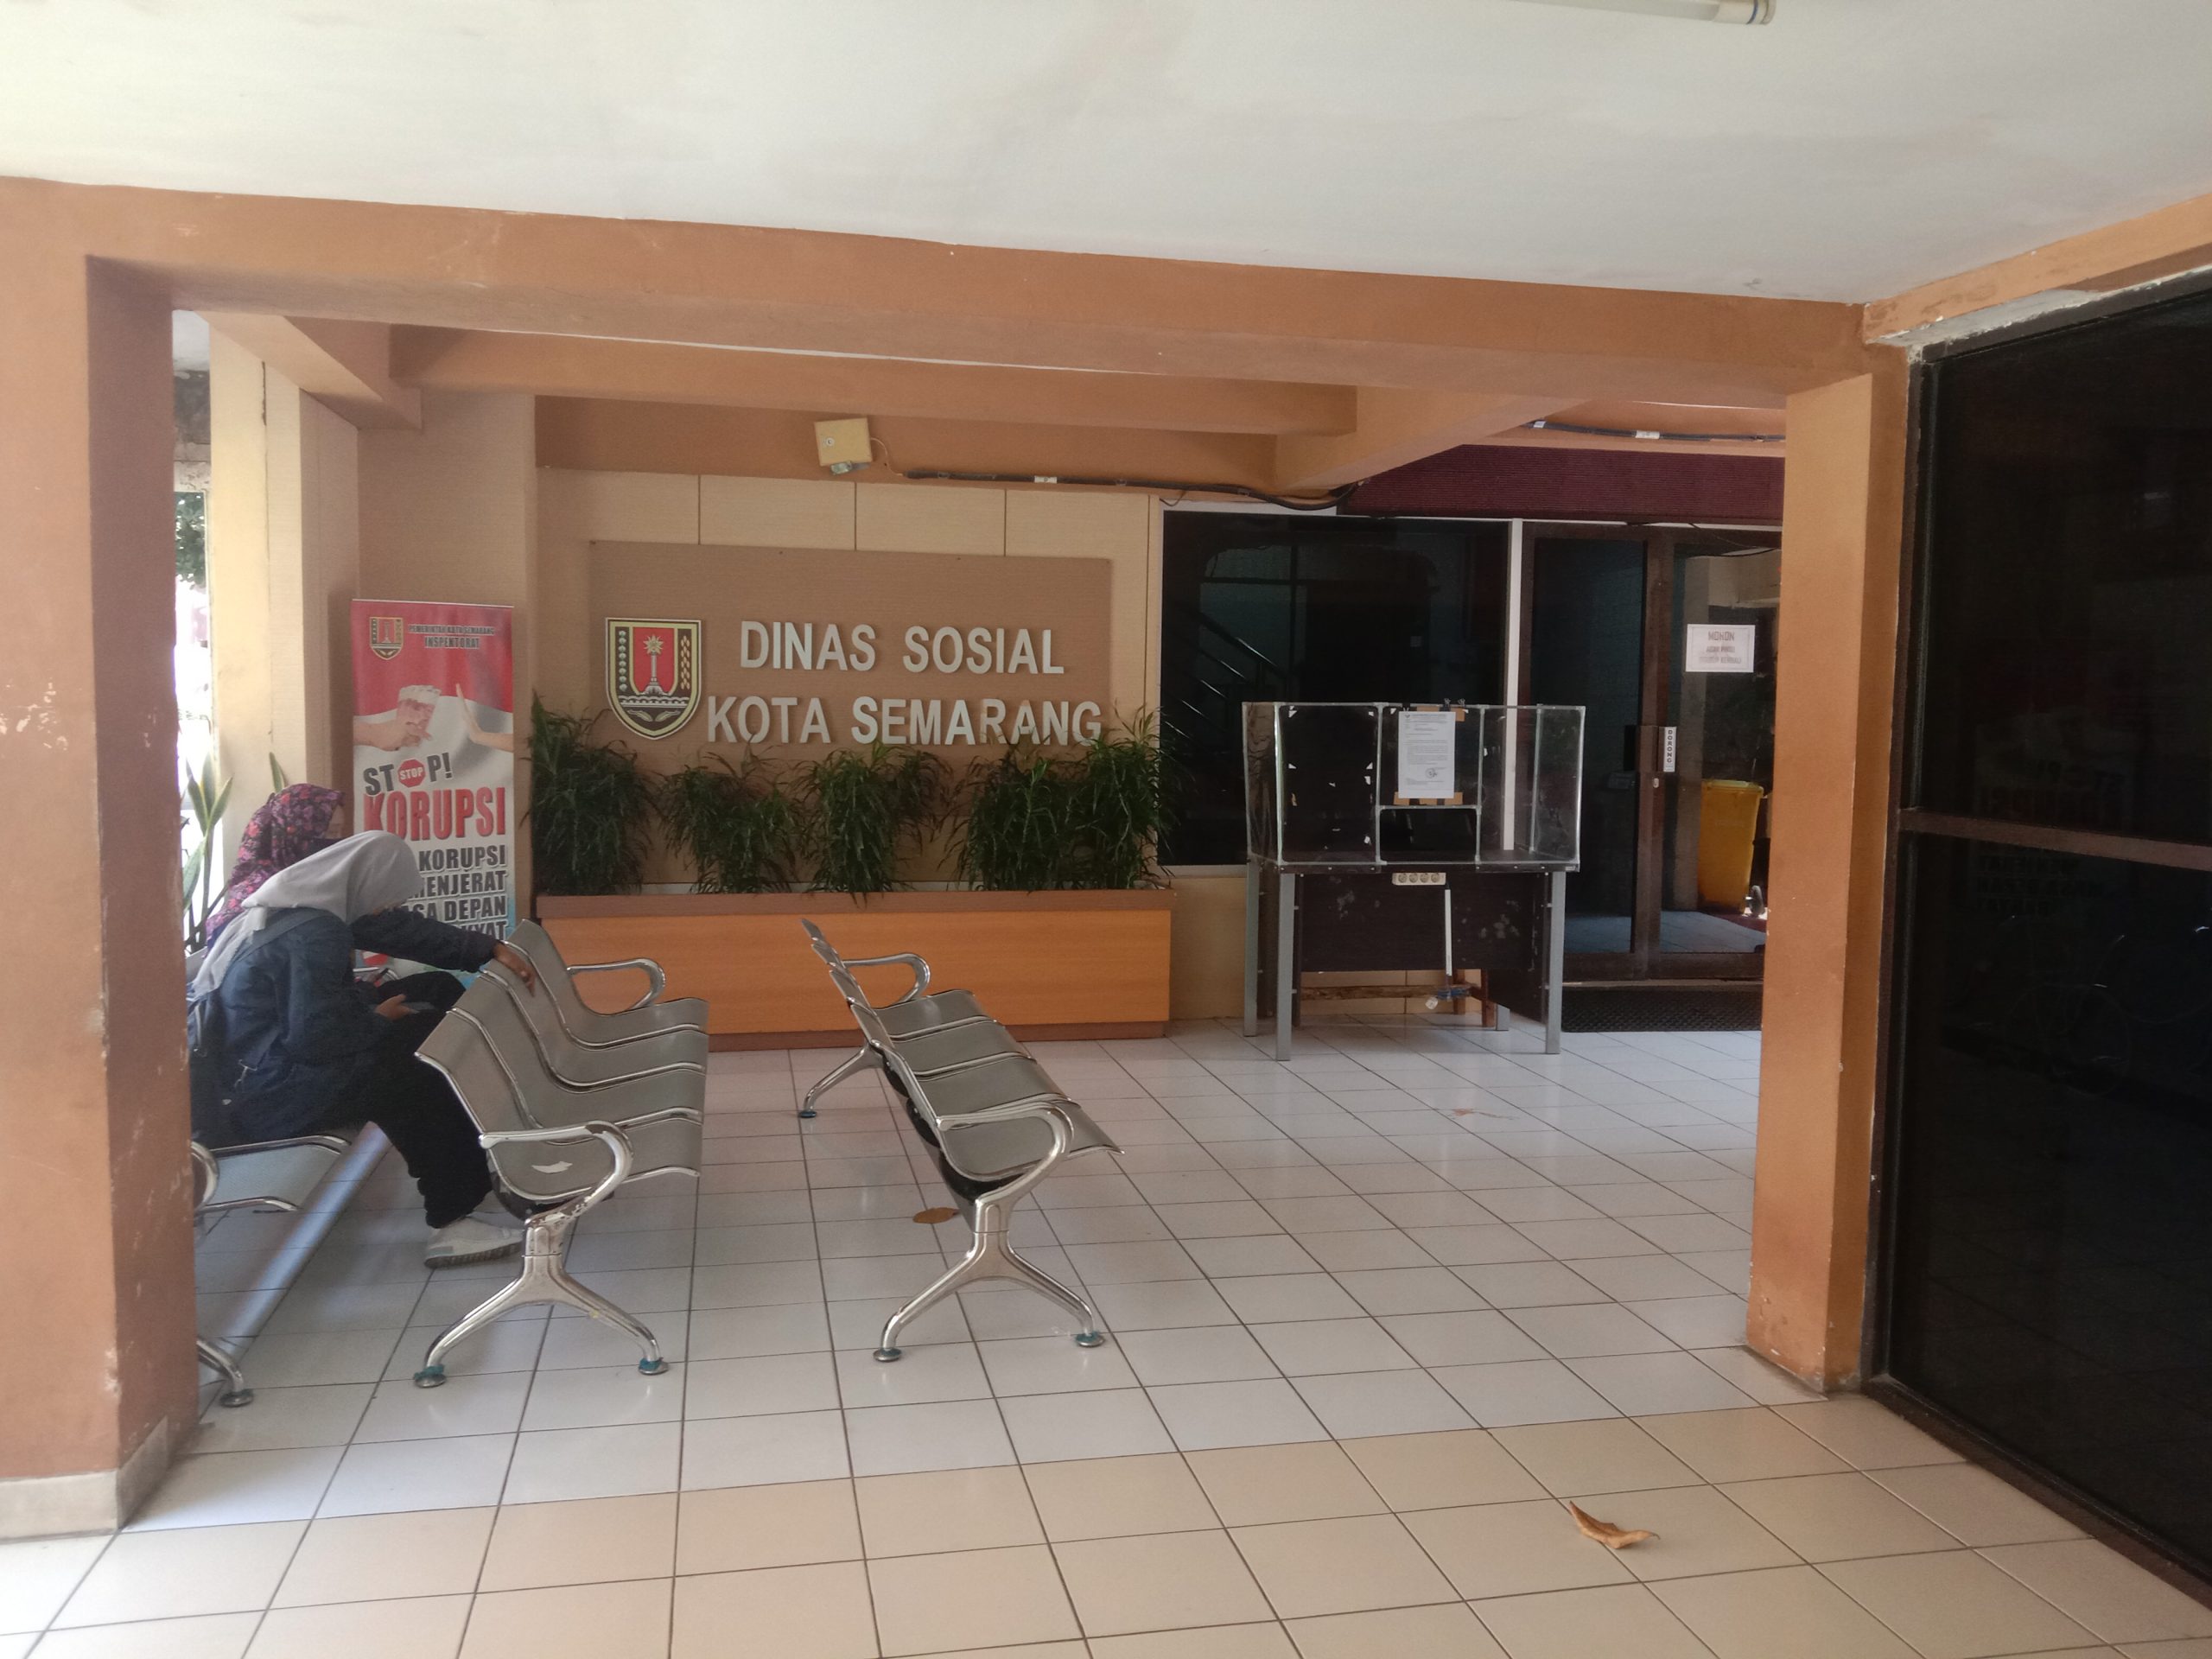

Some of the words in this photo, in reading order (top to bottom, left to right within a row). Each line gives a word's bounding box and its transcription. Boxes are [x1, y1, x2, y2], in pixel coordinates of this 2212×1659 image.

[424, 637, 480, 648] INSPEKTORAT
[741, 621, 876, 671] DINAS
[903, 626, 1065, 675] SOSIAL
[1708, 632, 1734, 641] MOHON
[708, 696, 831, 744] KOTA
[851, 696, 1102, 747] SEMARANG
[400, 767, 423, 780] STOP
[363, 787, 505, 842] KORUPSI
[419, 845, 505, 872] KORUPSI
[409, 870, 506, 898] ENJERAT
[444, 895, 506, 921] DEPAN
